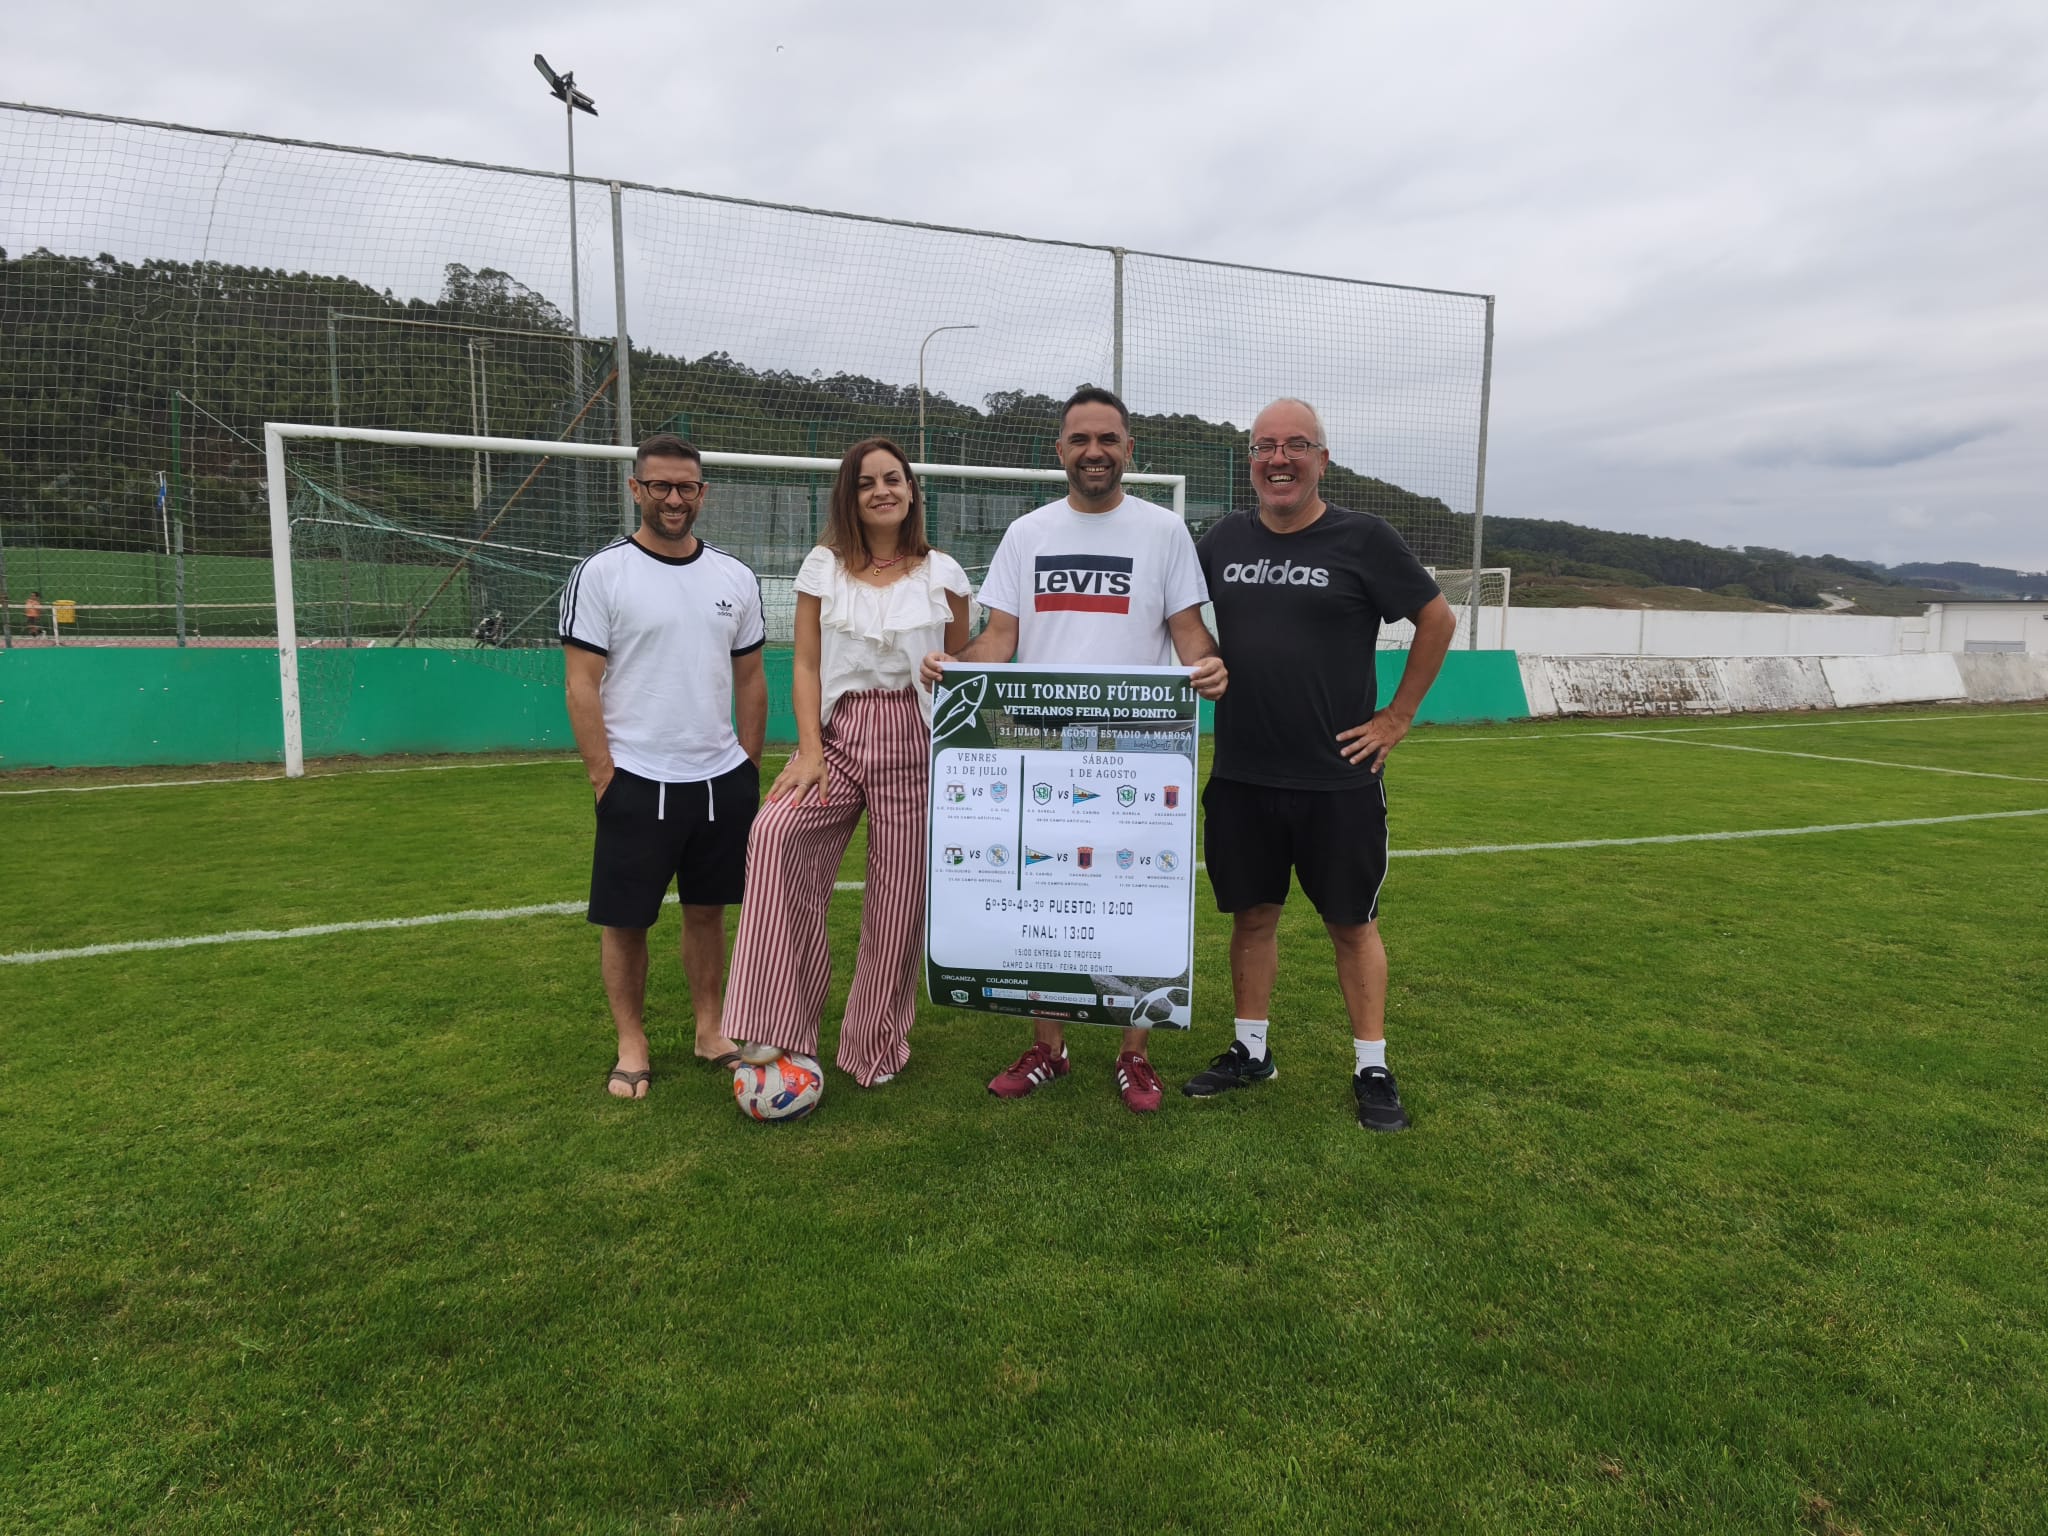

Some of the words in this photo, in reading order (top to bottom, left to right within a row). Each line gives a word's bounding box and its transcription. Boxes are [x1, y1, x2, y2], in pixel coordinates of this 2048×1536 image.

[1223, 558, 1330, 588] adidas
[995, 683, 1028, 699] VIII
[1032, 683, 1101, 700] TORNEO
[1106, 680, 1175, 702] FÚTBOL
[1181, 686, 1195, 702] 11
[1003, 705, 1074, 716] VETERANOS
[1075, 706, 1111, 717] FEIRA
[1113, 707, 1129, 718] DO
[1131, 708, 1177, 719] BONITO
[999, 727, 1011, 737] 31
[1013, 727, 1040, 738] JULIO
[1043, 728, 1049, 737] Y
[1051, 729, 1057, 737] 1
[1060, 728, 1098, 738] AGOSTO
[1100, 729, 1141, 739] ESTADIO
[1143, 730, 1151, 739] A
[1153, 730, 1192, 740] MAROSA
[957, 752, 998, 762] VENRES
[1082, 754, 1124, 765] SÁBADO
[945, 765, 958, 775] 31
[962, 766, 976, 775] DE
[979, 766, 1008, 776] JULIO
[1069, 768, 1074, 778] 1
[1079, 768, 1092, 778] DE
[1095, 769, 1137, 779] AGOSTO
[972, 787, 983, 797] VS
[1057, 790, 1069, 800] VS
[1144, 792, 1156, 802] VS
[969, 849, 981, 859] VS
[1057, 852, 1068, 862] VS
[1140, 856, 1151, 865] VS
[1049, 899, 1096, 914] PUESTO:
[1102, 901, 1134, 915] 12:00
[1022, 924, 1057, 939] FINAL:
[1064, 926, 1095, 941] 13:00
[1034, 949, 1061, 958] ENTREGA
[1063, 950, 1072, 958] DE
[1073, 950, 1102, 959] TROFEOS
[1002, 961, 1023, 969] CAMPO
[1025, 961, 1033, 969] DA
[1035, 962, 1054, 970] FESTA
[1059, 963, 1077, 971] FEIRA
[1079, 964, 1088, 972] DO
[1090, 964, 1113, 973] BONITO
[941, 974, 976, 982] ORGANIZA
[986, 977, 1029, 985] COLABORAN
